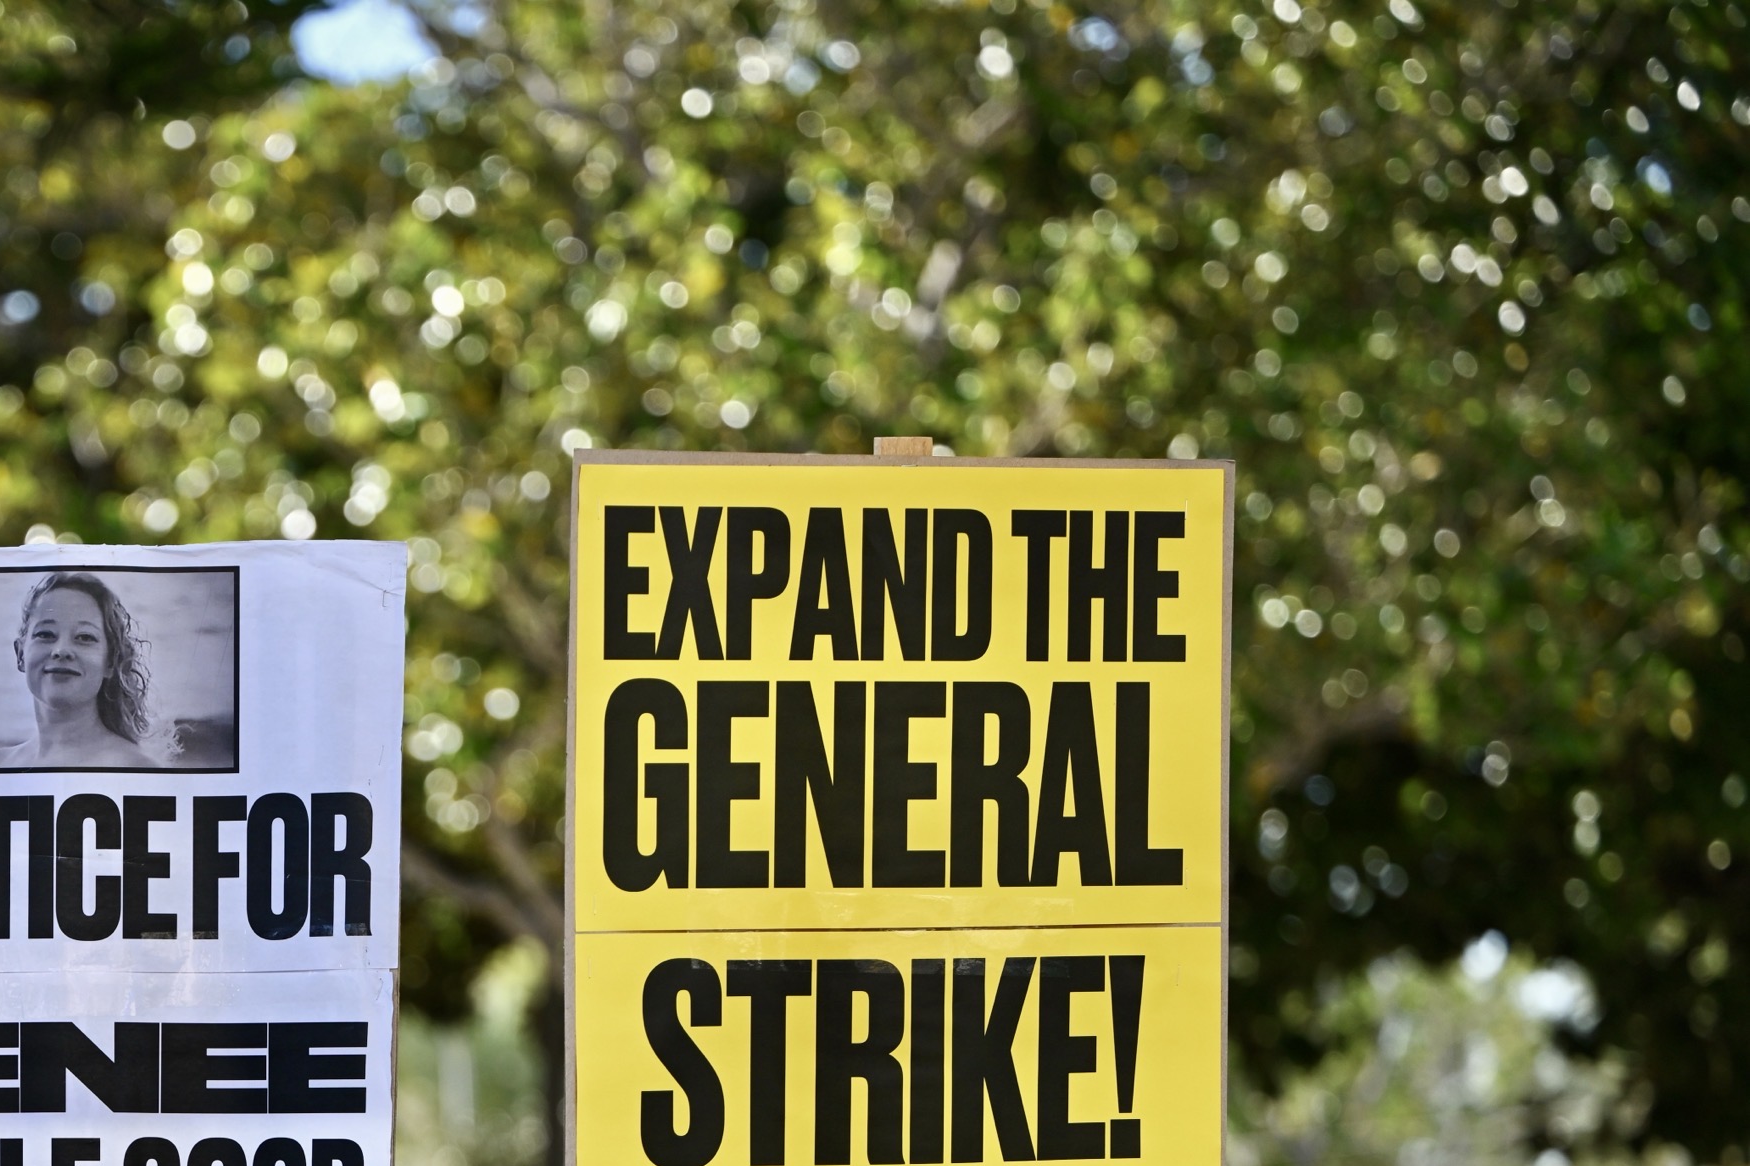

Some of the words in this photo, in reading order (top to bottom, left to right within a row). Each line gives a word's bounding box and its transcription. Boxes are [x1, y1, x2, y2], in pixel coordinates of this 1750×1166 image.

[604, 506, 992, 661] EXPAND
[1012, 510, 1187, 662] THE
[603, 678, 1183, 892] GENERAL
[193, 792, 373, 940] FOR
